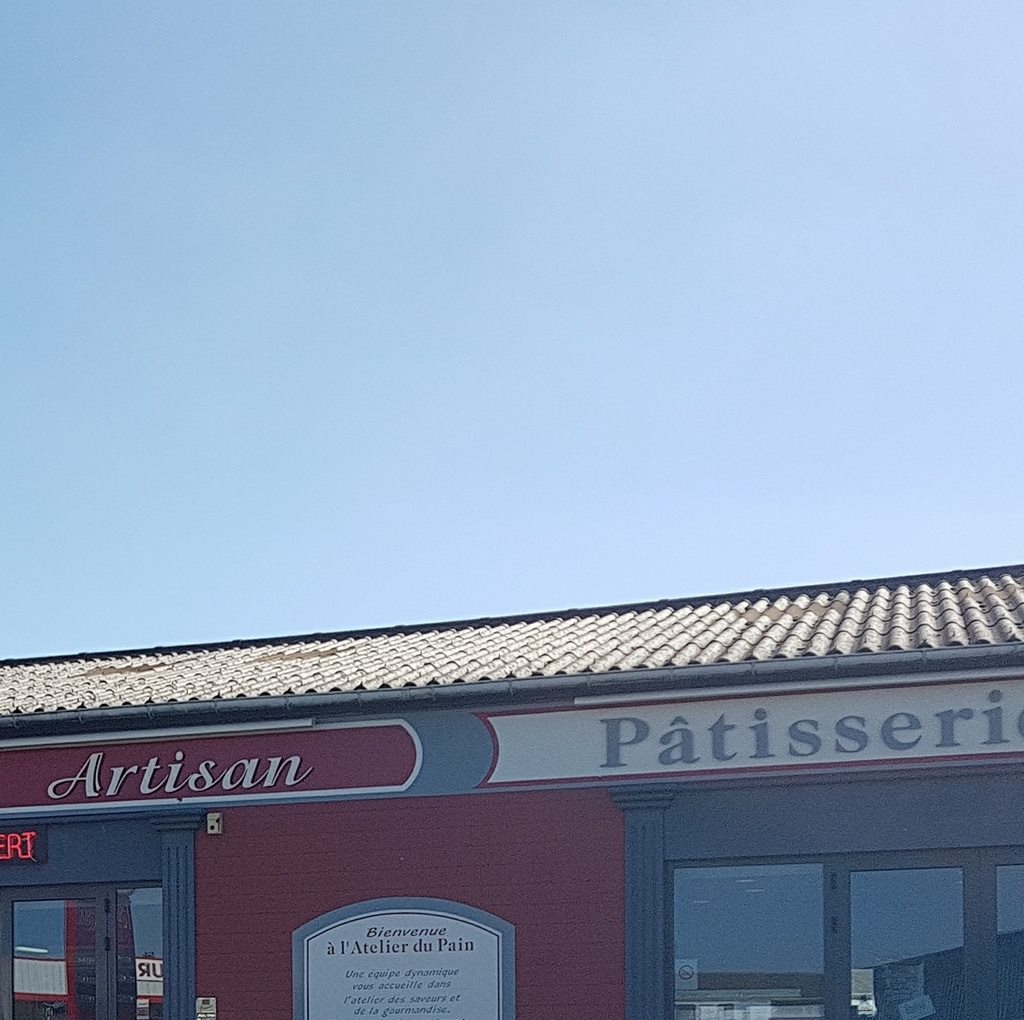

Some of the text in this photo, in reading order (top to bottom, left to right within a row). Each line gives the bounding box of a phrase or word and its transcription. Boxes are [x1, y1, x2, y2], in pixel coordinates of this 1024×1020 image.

[599, 689, 1024, 769] Pâtisseri
[47, 750, 314, 800] Artisan
[366, 927, 448, 938] Bienvenue
[327, 937, 475, 955] à l'Atelier du Pain
[345, 970, 365, 979] Une
[405, 967, 460, 978] dynamique
[378, 980, 423, 990] accueille
[427, 979, 451, 989] dans
[343, 993, 461, 1005] l'atelier des saveurs et
[353, 1004, 451, 1018] de la gourmandise.
